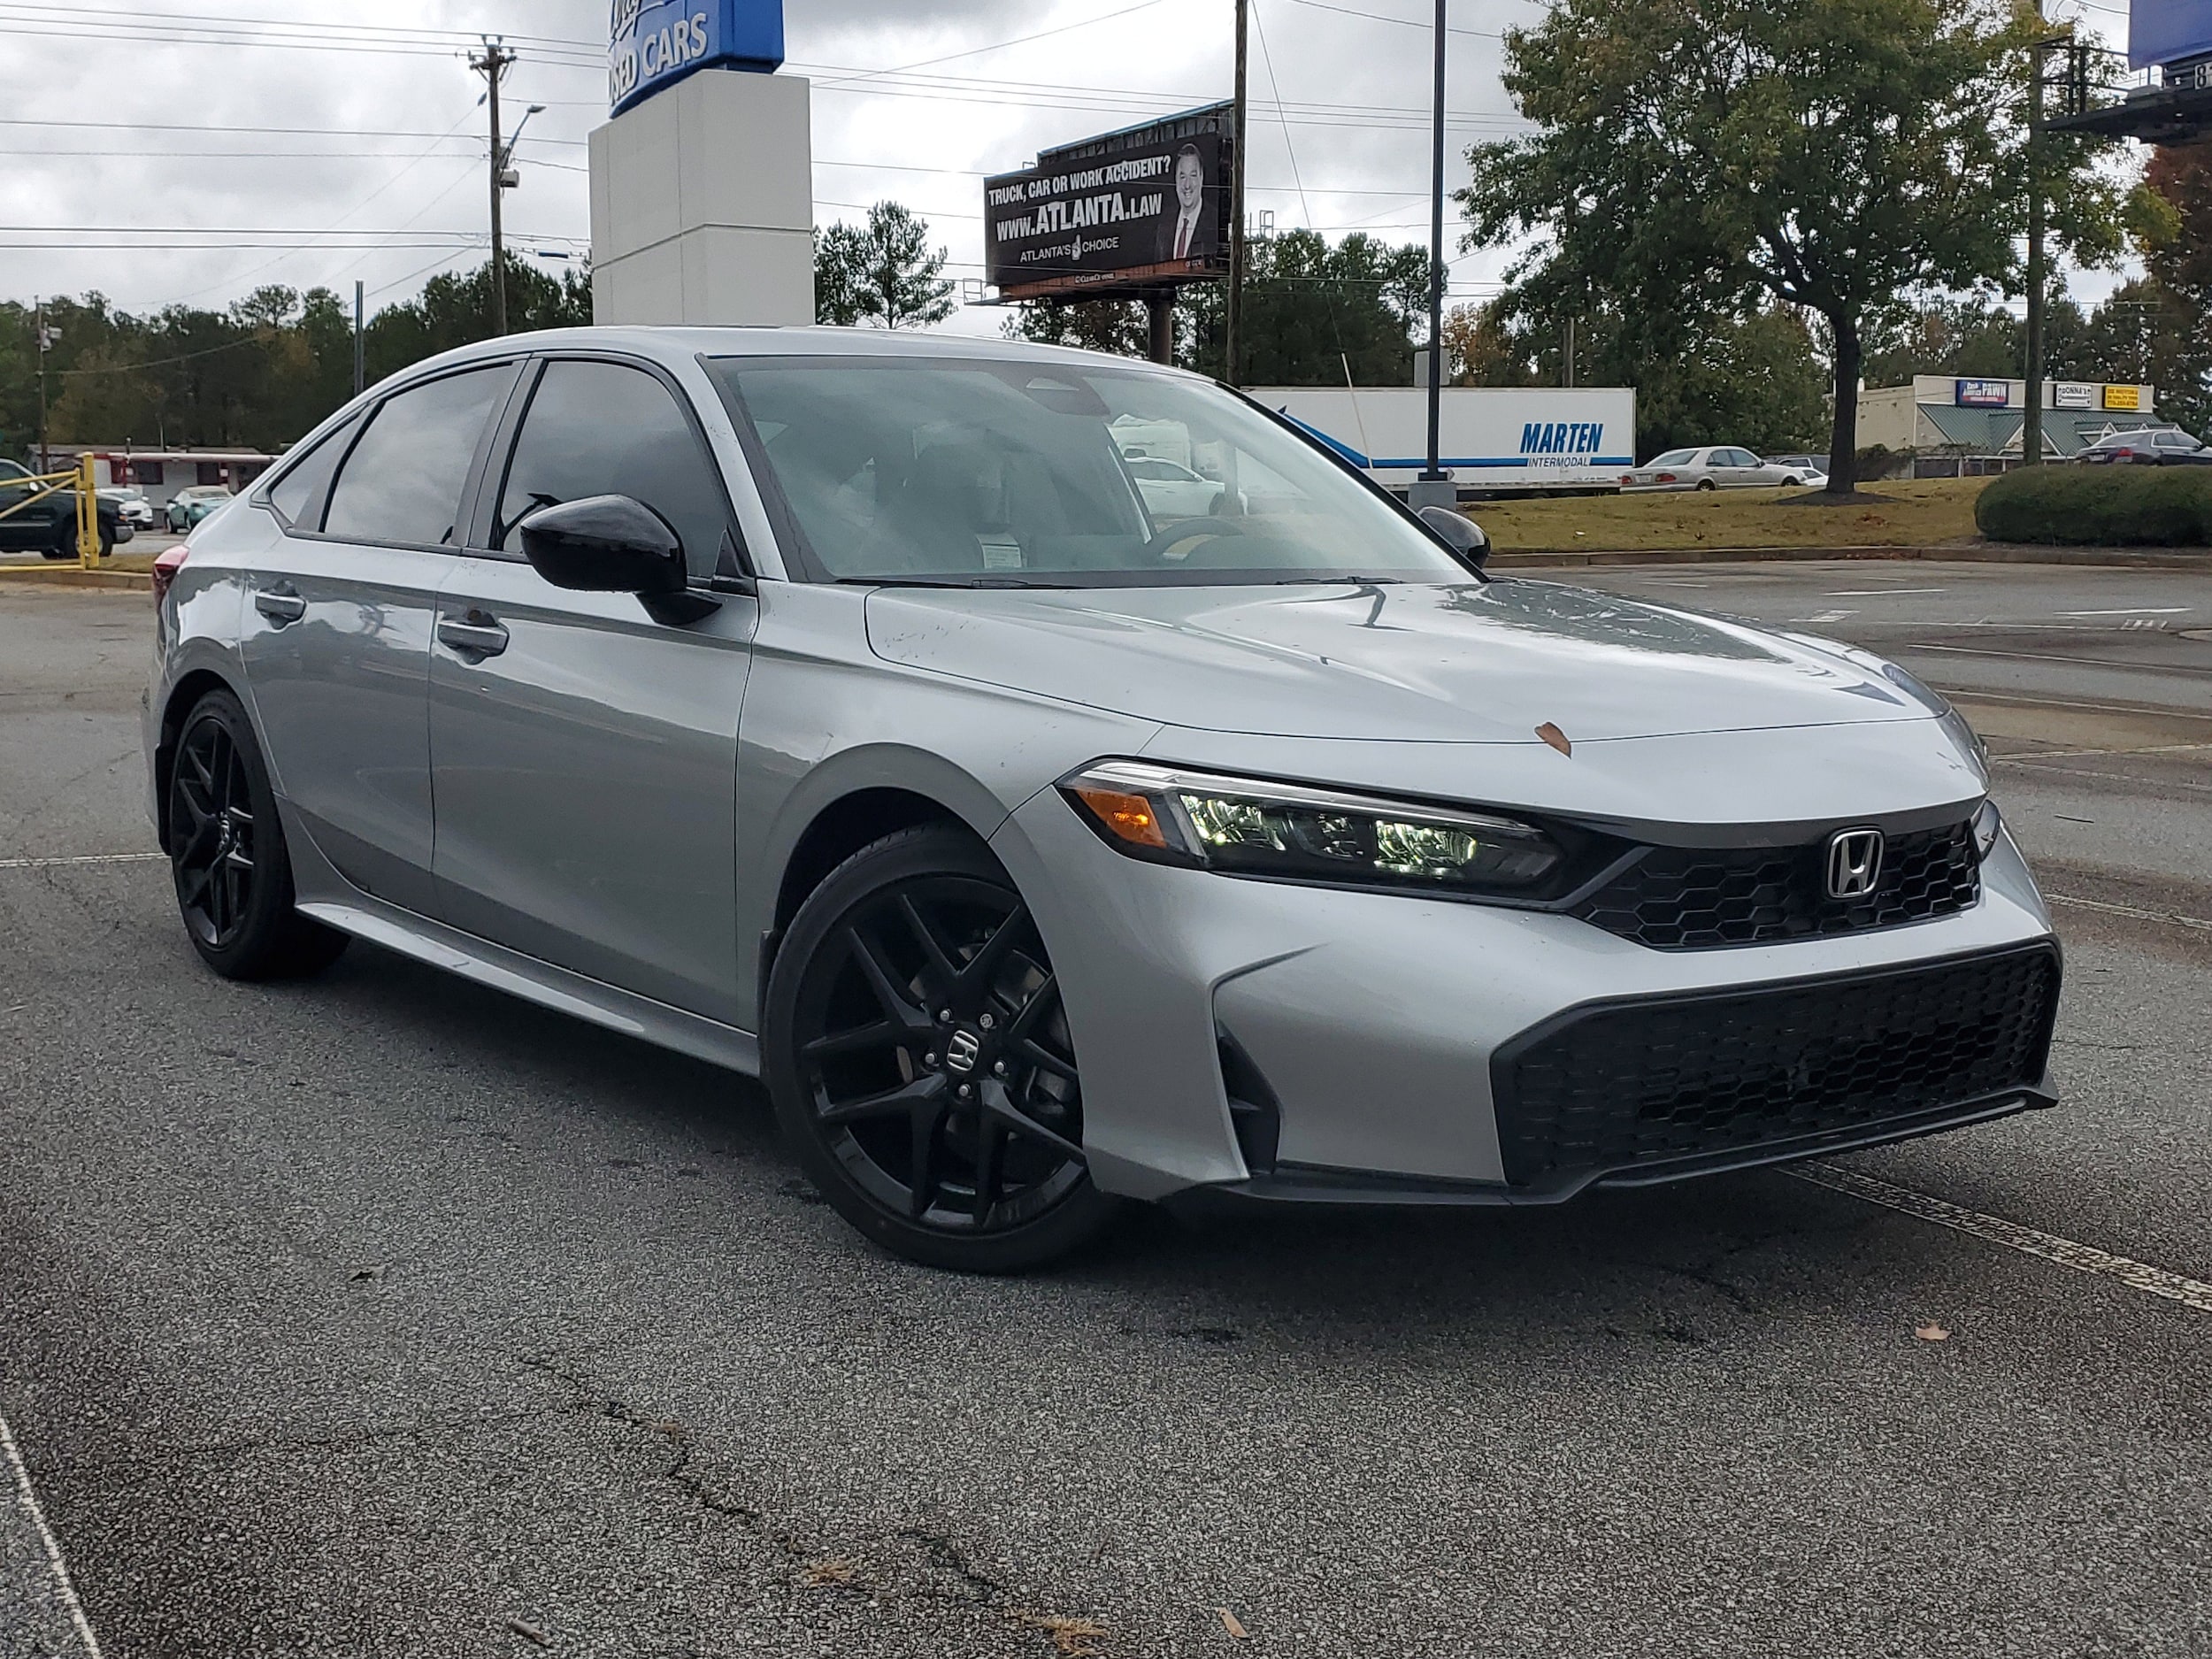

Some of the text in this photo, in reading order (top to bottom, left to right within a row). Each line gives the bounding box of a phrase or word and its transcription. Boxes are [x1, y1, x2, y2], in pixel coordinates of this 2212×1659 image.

[641, 12, 707, 77] CARS
[988, 155, 1171, 206] TRUCK, CAR OR WORK ACCIDENT?
[996, 192, 1163, 242] WWW.ATLANTA.LAW
[1019, 236, 1119, 263] ATLANTA'S CHOICE
[1982, 382, 2007, 396] PAWN
[1519, 423, 1603, 453] MARTEN
[1528, 457, 1588, 467] INTERMODAL
